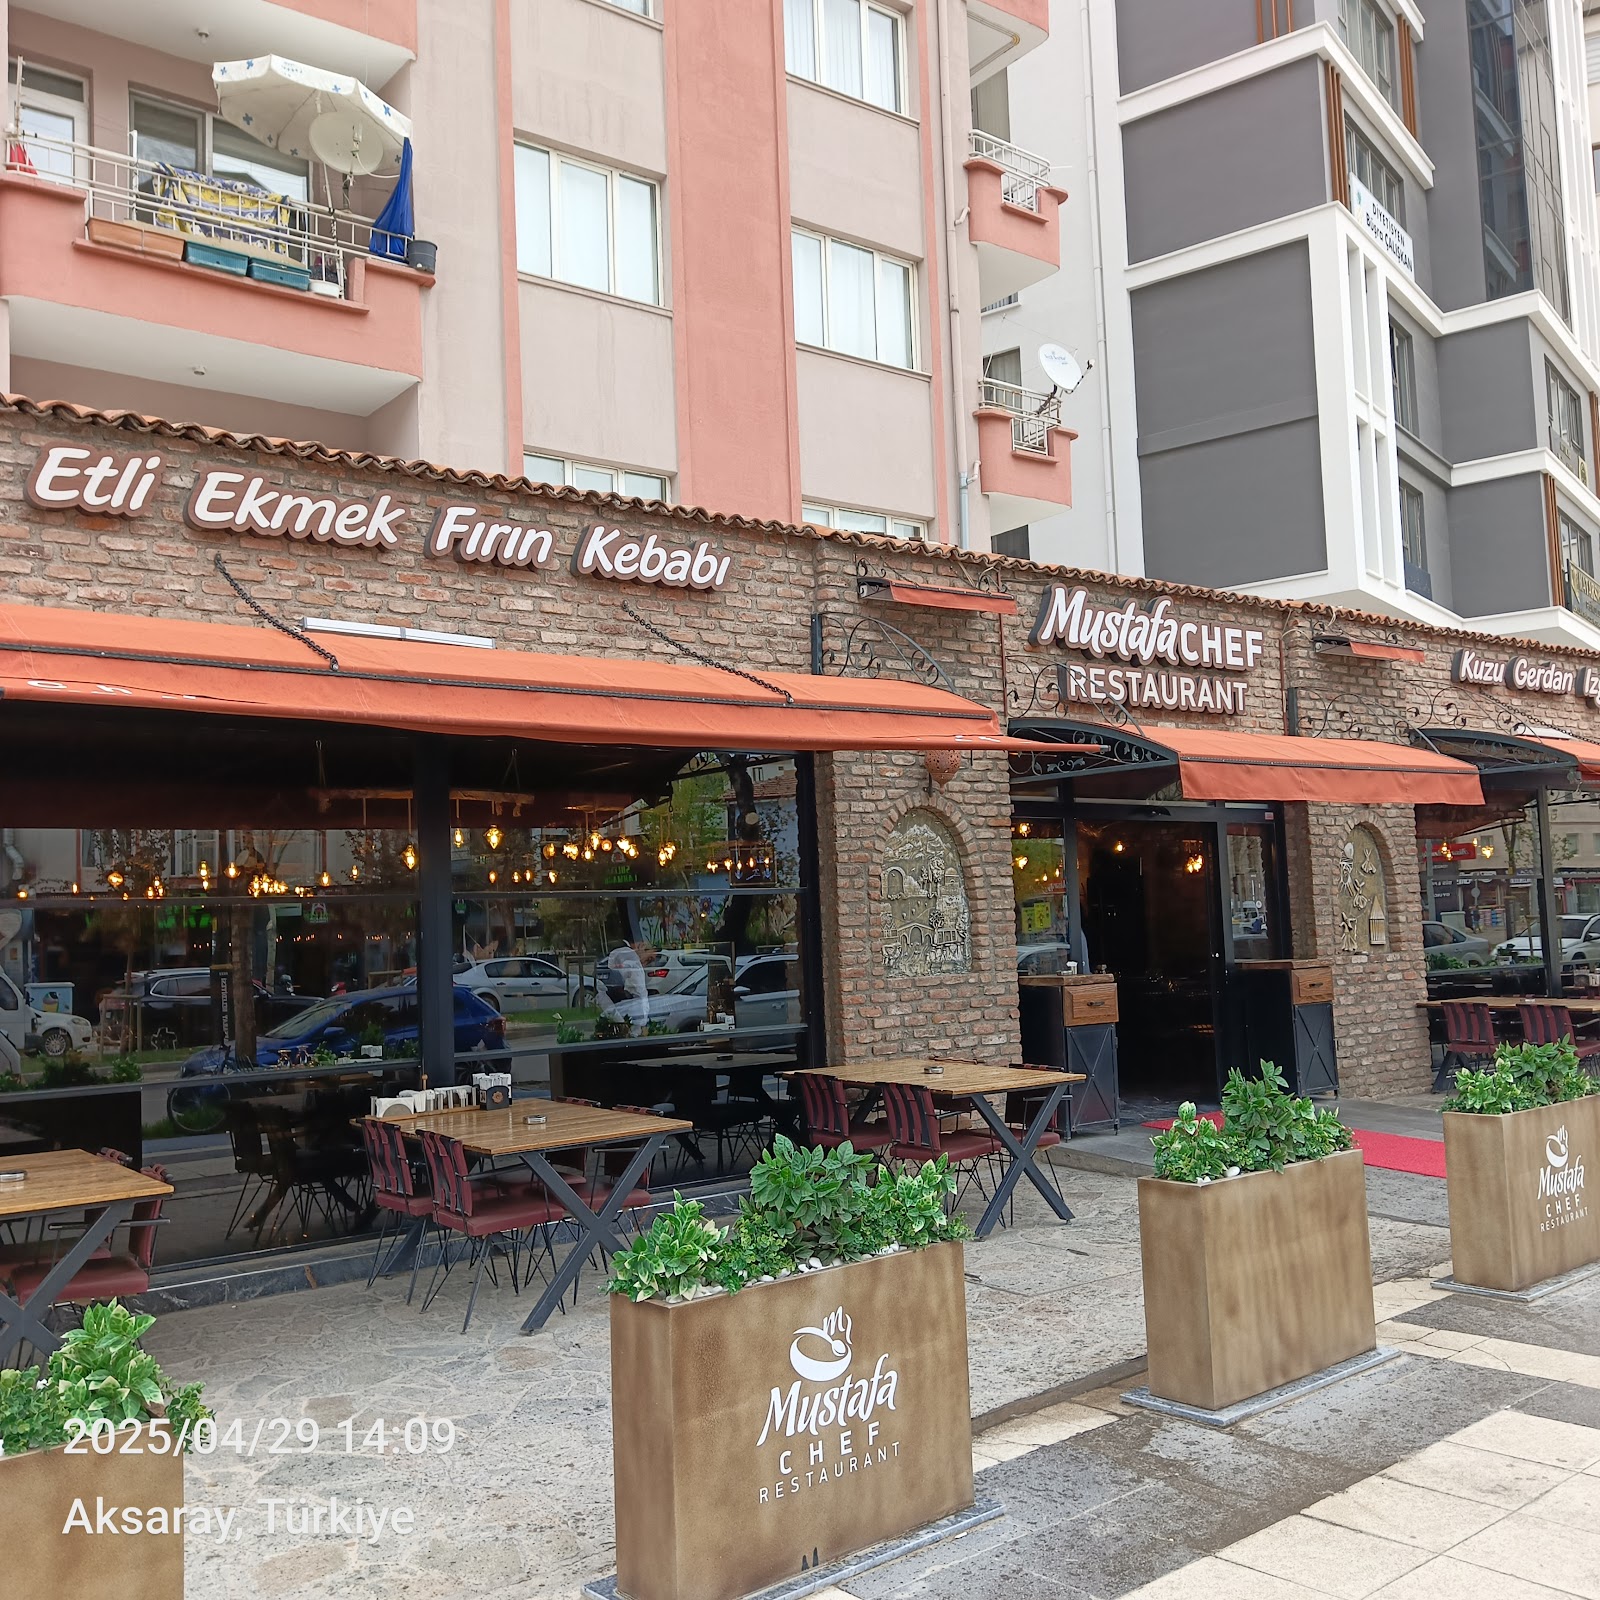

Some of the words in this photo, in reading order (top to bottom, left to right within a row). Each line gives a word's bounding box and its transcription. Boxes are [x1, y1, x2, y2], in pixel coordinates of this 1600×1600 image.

[1366, 212, 1383, 241] Büşra
[1384, 233, 1413, 273] ÇALIŞKAN
[1372, 202, 1405, 247] DİYETİSYEN
[35, 447, 161, 510] Etli
[194, 471, 406, 543] Ekmek
[436, 507, 553, 563] Fırın
[582, 527, 731, 586] Kebabı
[1068, 664, 1249, 713] RESTAURANT
[1461, 650, 1505, 683] Kuzu
[1514, 658, 1573, 692] Gerdan
[1537, 1154, 1585, 1200] Mustafa
[1540, 1206, 1589, 1233] RESTAURANT
[1545, 1193, 1581, 1218] CHEF
[756, 1352, 898, 1447] Mustafa
[779, 1420, 880, 1475] CHEF
[759, 1441, 901, 1504] RESTAURANT
